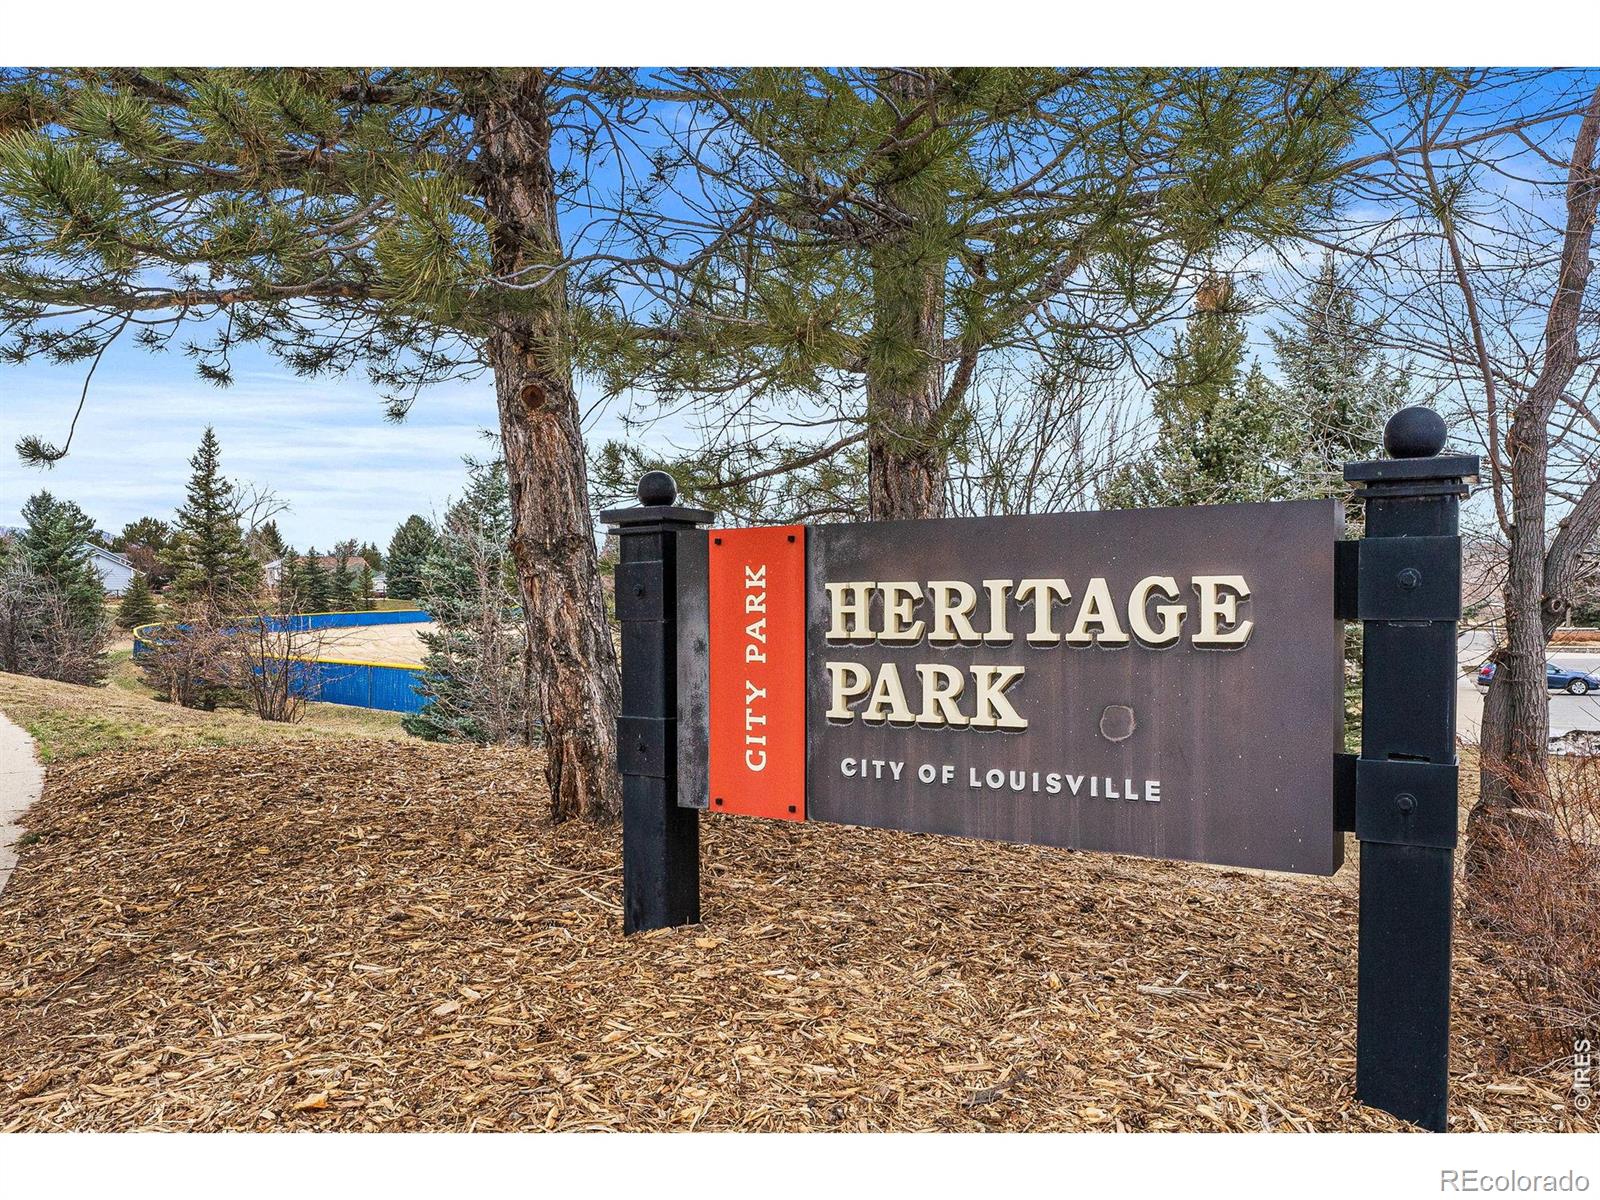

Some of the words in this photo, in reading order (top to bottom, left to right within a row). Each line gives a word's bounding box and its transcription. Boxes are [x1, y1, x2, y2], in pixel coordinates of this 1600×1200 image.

[744, 564, 767, 664] PARK
[825, 575, 1254, 647] HERITAGE
[744, 679, 768, 772] CITY
[825, 661, 1029, 730] PARK
[840, 757, 905, 783] CITY
[917, 764, 955, 785] OF
[969, 767, 1162, 803] LOUISVILLE
